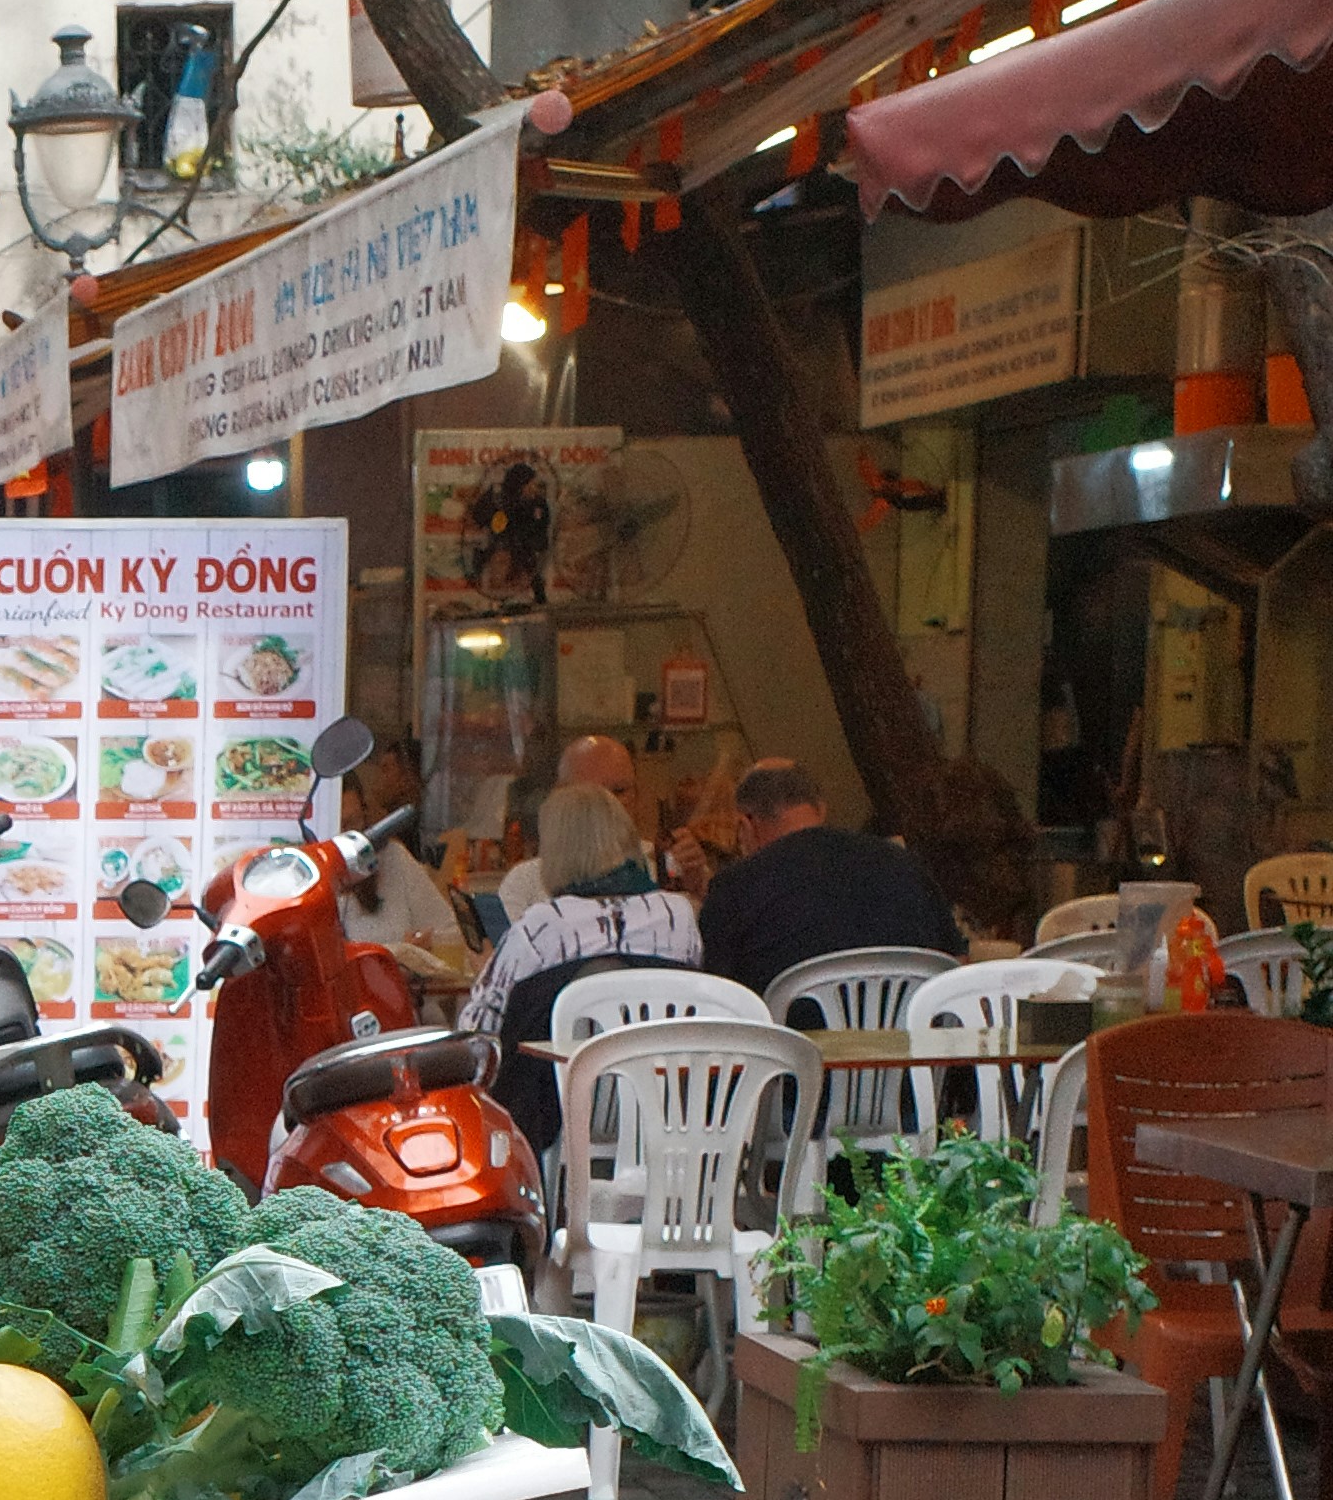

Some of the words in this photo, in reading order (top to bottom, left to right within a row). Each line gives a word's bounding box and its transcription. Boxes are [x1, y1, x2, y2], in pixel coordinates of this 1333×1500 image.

[121, 548, 177, 593] KỲ
[194, 542, 317, 594] ĐỒNG
[100, 602, 126, 623] Ky
[133, 602, 188, 623] Dong
[196, 602, 314, 618] Restaurant
